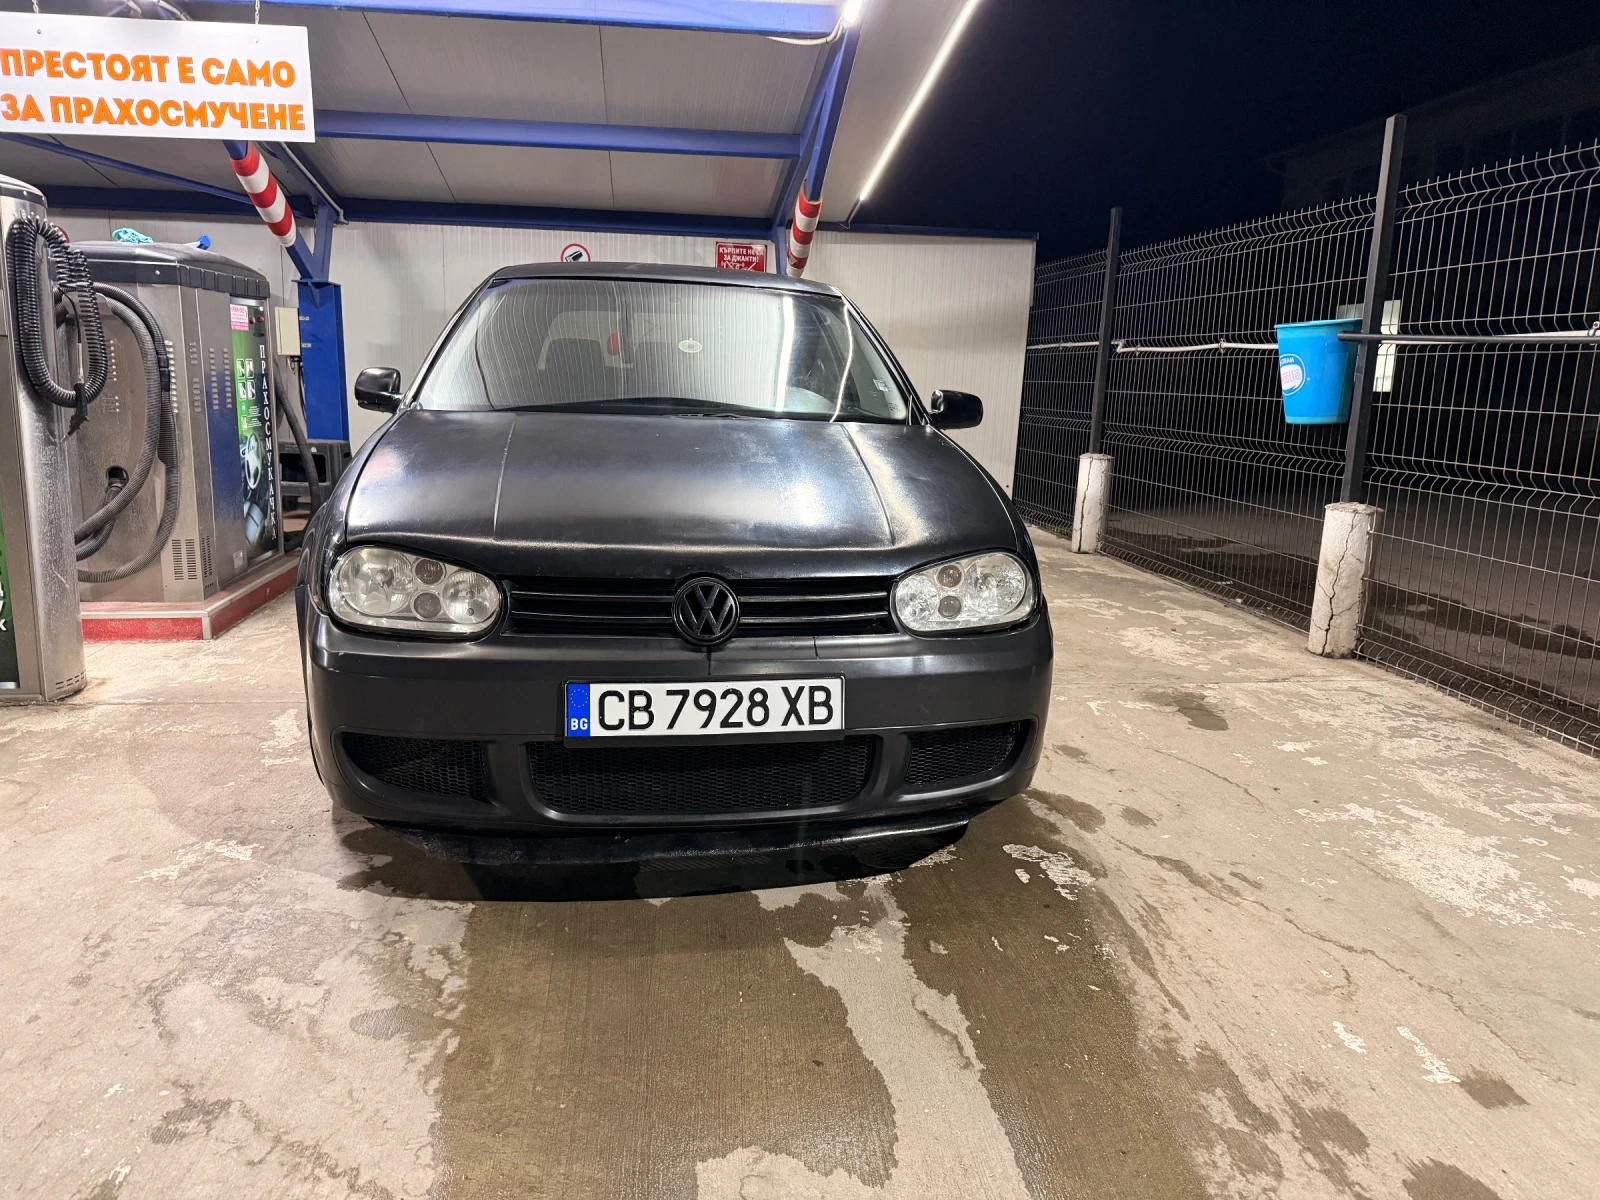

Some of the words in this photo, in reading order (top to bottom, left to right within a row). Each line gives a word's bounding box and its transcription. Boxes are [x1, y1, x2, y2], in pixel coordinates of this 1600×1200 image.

[0, 48, 169, 83] ПРЕСТОЯТ
[177, 56, 195, 83] Е
[202, 58, 295, 88] САМО
[0, 93, 45, 121] ЗА
[49, 96, 305, 131] ПРАХОСМУЧЕНЕ
[732, 255, 759, 263] ДЖАНТИ!
[259, 344, 277, 540] ПРАХОСМУКАЧКА
[570, 717, 589, 731] BG
[665, 687, 770, 730] 7928
